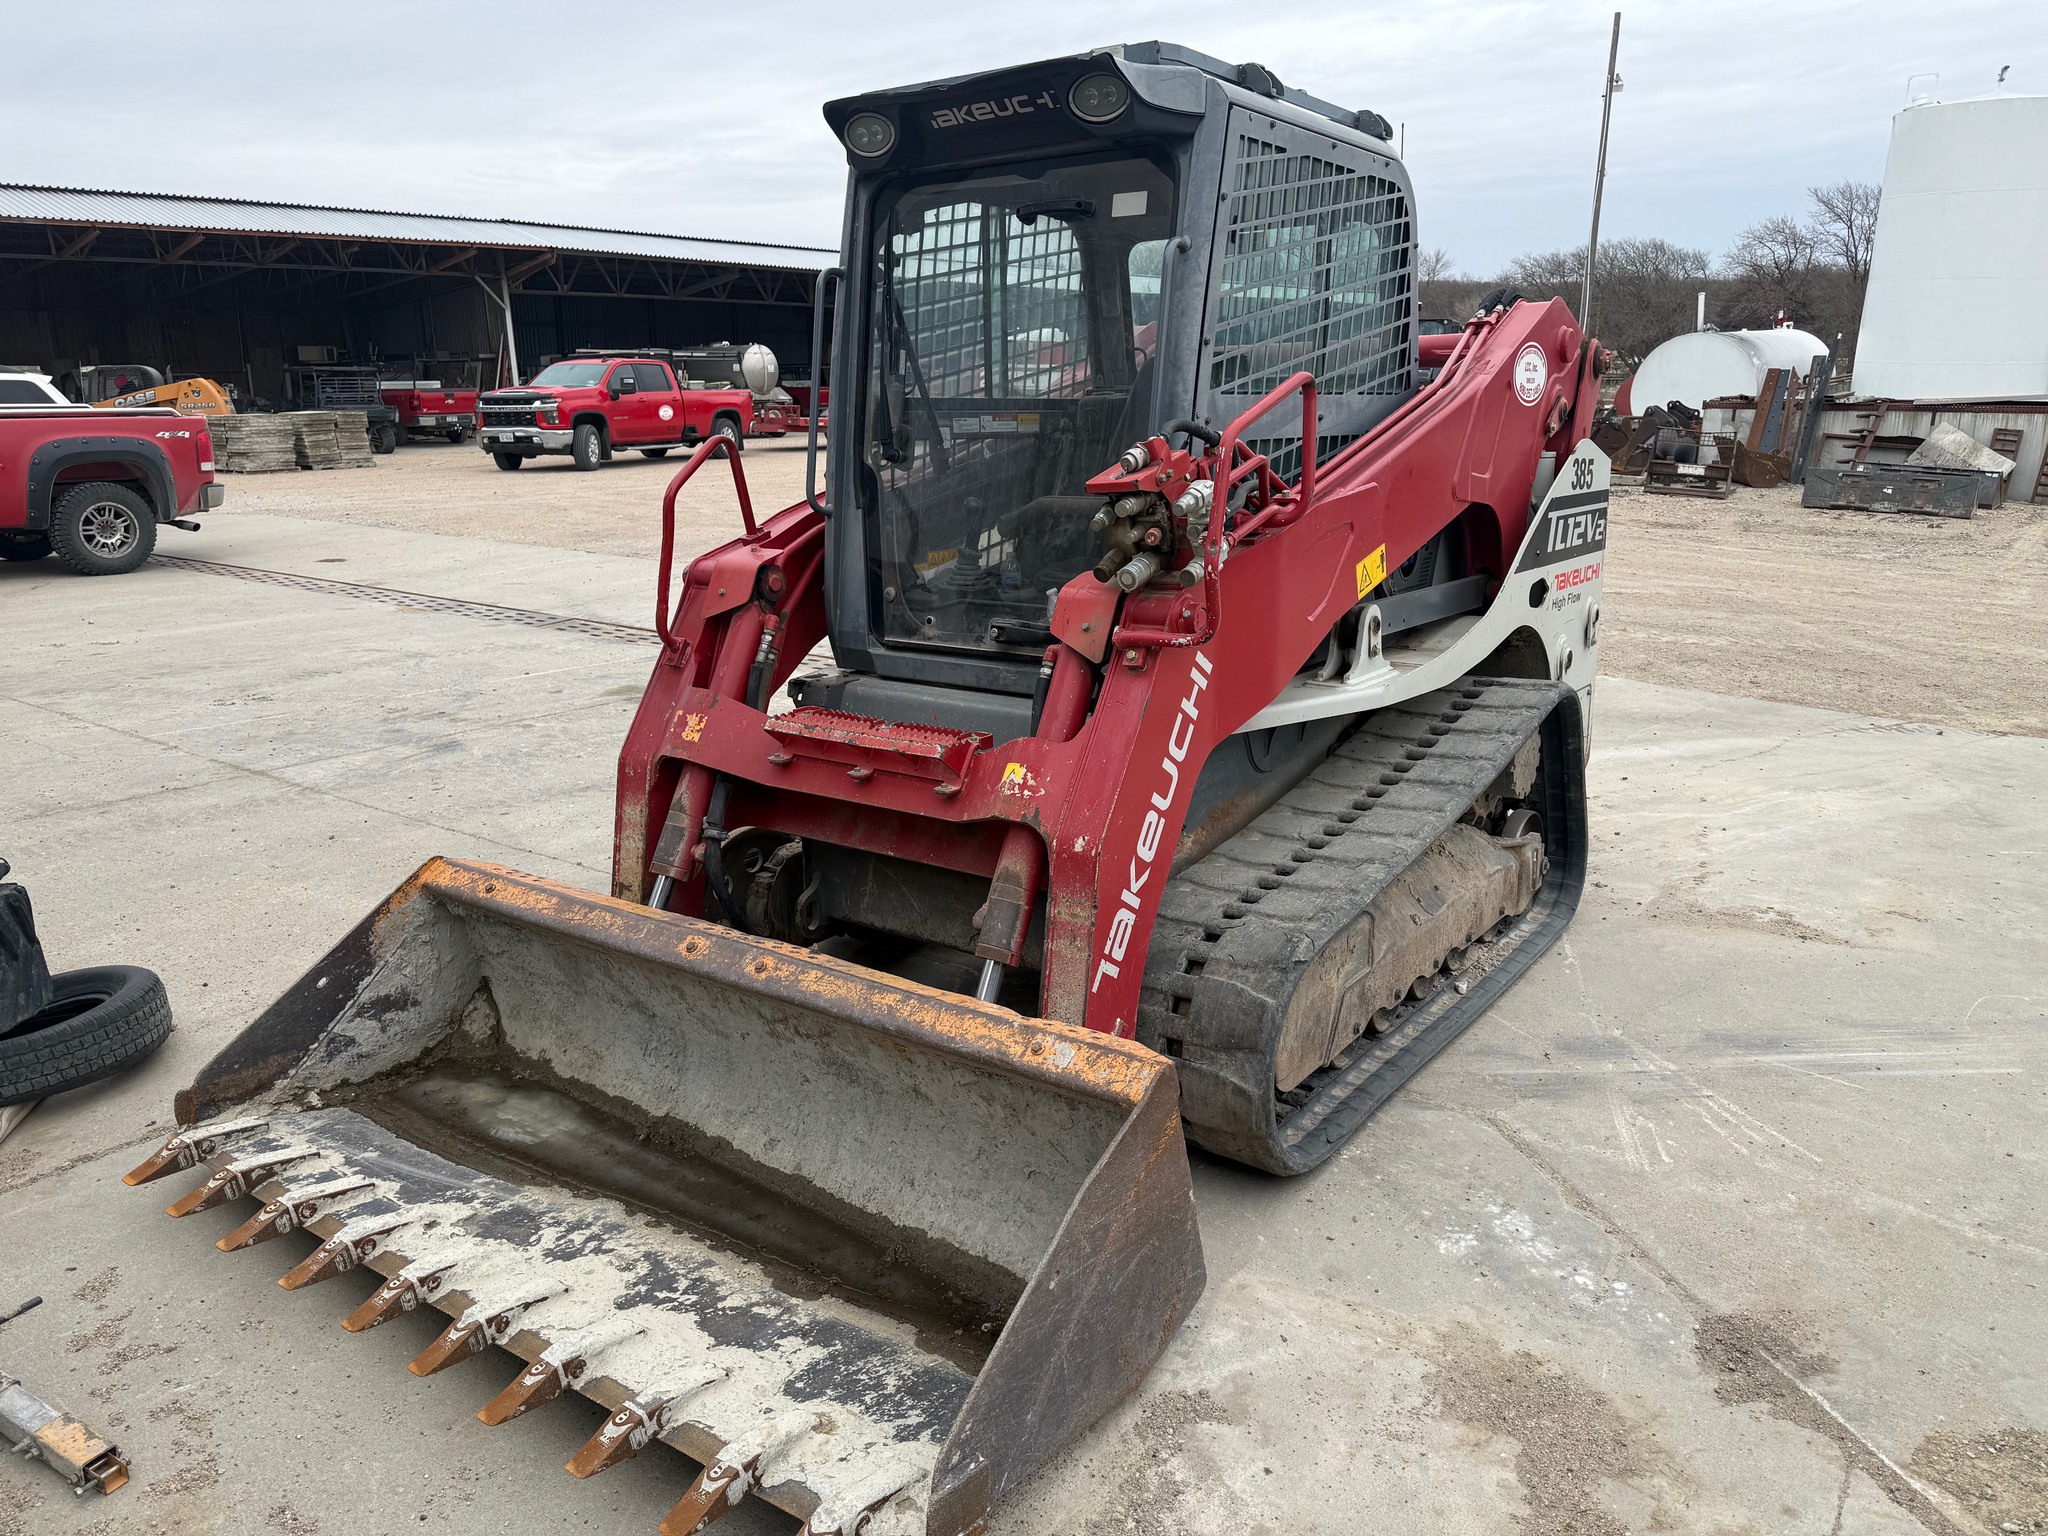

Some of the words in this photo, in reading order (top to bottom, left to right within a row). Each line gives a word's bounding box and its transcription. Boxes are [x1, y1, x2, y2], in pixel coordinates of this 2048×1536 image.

[113, 390, 157, 408] CASE
[1571, 457, 1595, 491] 385
[1551, 592, 1567, 612] High
[1567, 591, 1582, 607] Flow
